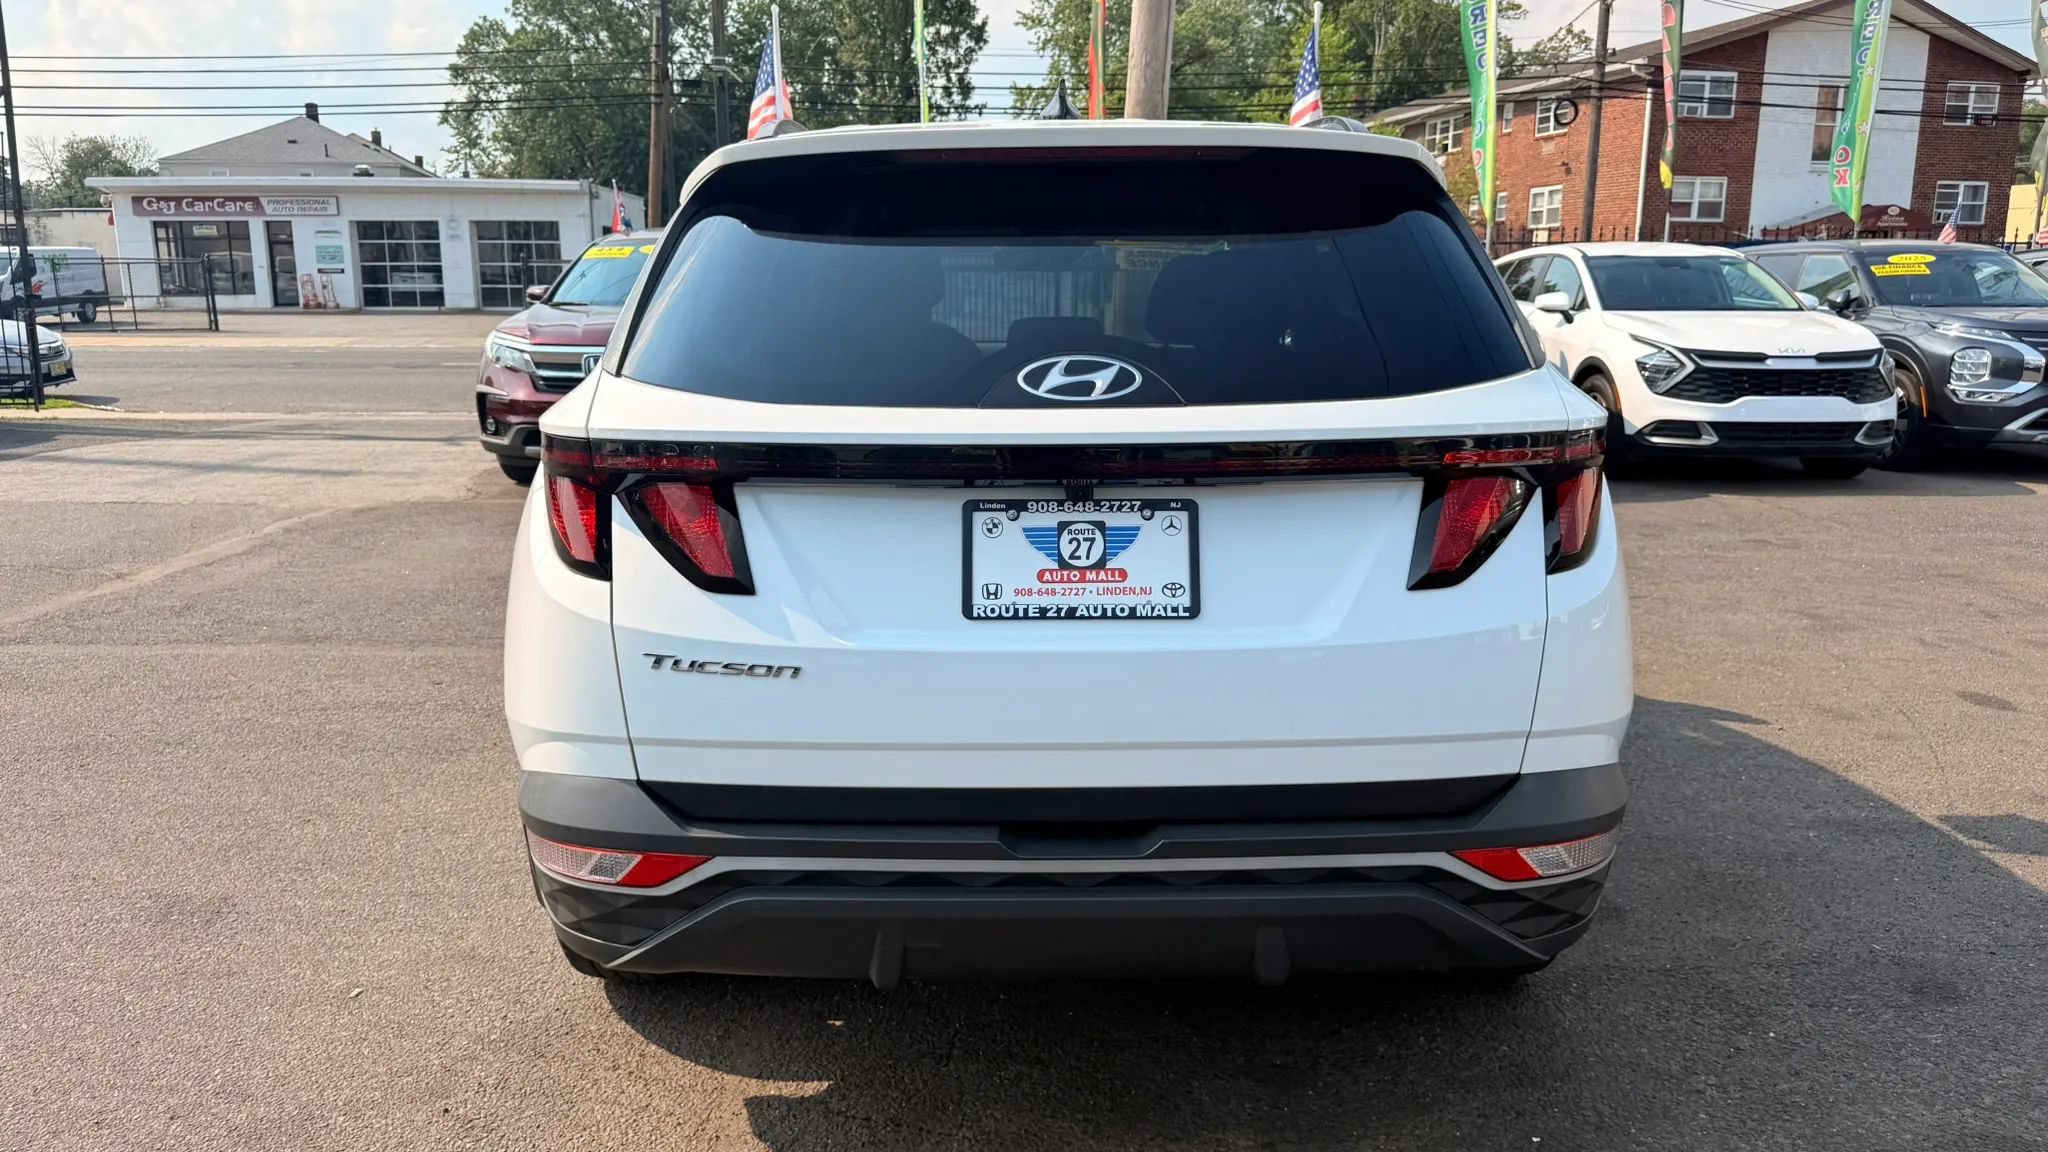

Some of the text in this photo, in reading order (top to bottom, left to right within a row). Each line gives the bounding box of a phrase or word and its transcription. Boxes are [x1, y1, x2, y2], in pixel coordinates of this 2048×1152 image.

[182, 198, 255, 212] CarCare
[266, 198, 332, 206] PROFESSIONAL
[1027, 501, 1142, 513] 908-648-2727
[1067, 528, 1096, 536] ROUTE
[1067, 537, 1096, 560] 27
[1042, 570, 1122, 581] AUTO MALL
[1014, 587, 1086, 597] 908-648-2727
[972, 603, 1190, 617] ROUTE 27 AUTO MALL
[642, 652, 802, 679] Tucson
